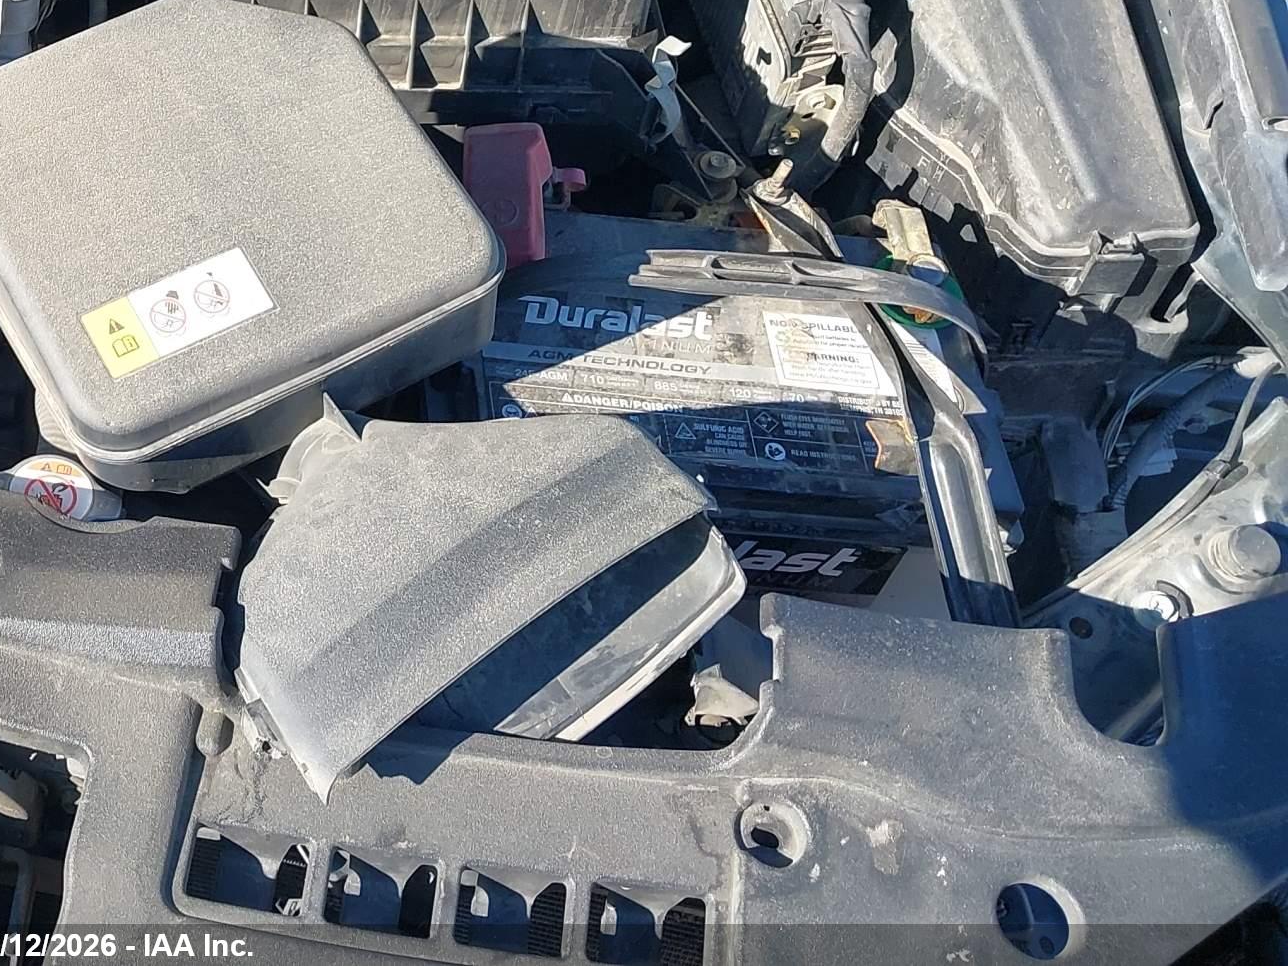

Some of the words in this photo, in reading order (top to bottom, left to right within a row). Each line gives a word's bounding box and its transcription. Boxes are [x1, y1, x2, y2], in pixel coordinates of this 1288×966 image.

[518, 296, 713, 341] Duralast
[528, 349, 573, 362] AGM
[583, 354, 711, 375] TECHNOLOGY
[580, 373, 605, 385] 710
[573, 395, 684, 413] DANGER/POISON
[730, 388, 751, 398] 120
[733, 540, 861, 577] last
